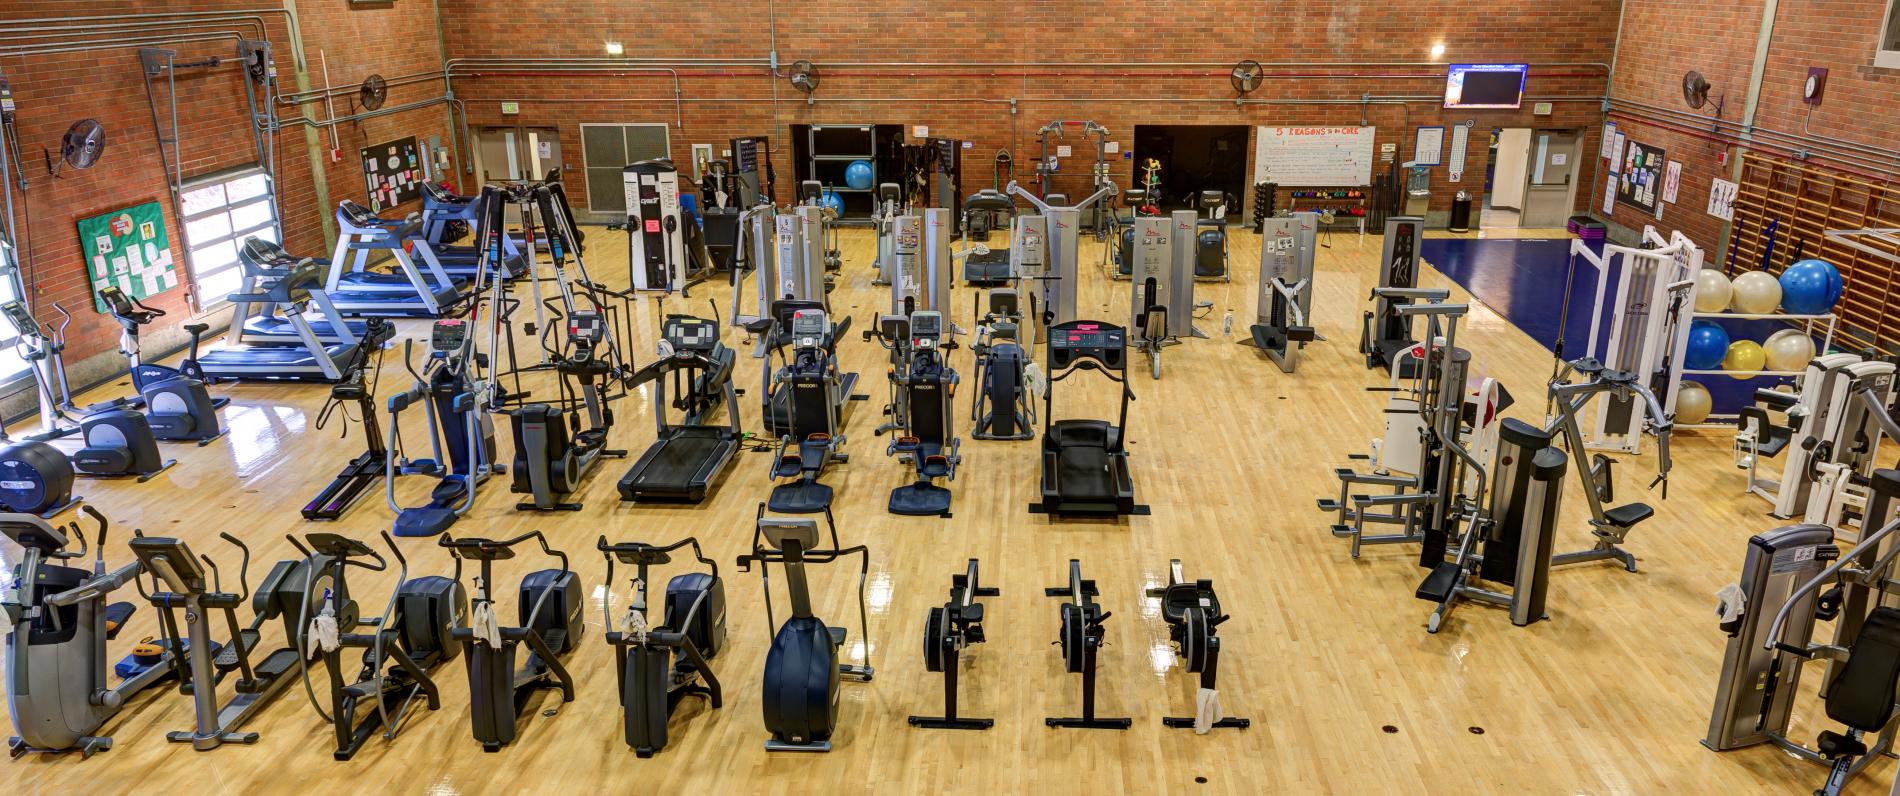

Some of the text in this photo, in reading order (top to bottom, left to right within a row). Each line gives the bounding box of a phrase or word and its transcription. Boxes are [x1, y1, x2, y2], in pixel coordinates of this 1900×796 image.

[1276, 127, 1283, 136] 5
[1289, 127, 1326, 136] REASONS
[1341, 127, 1359, 135] CORE
